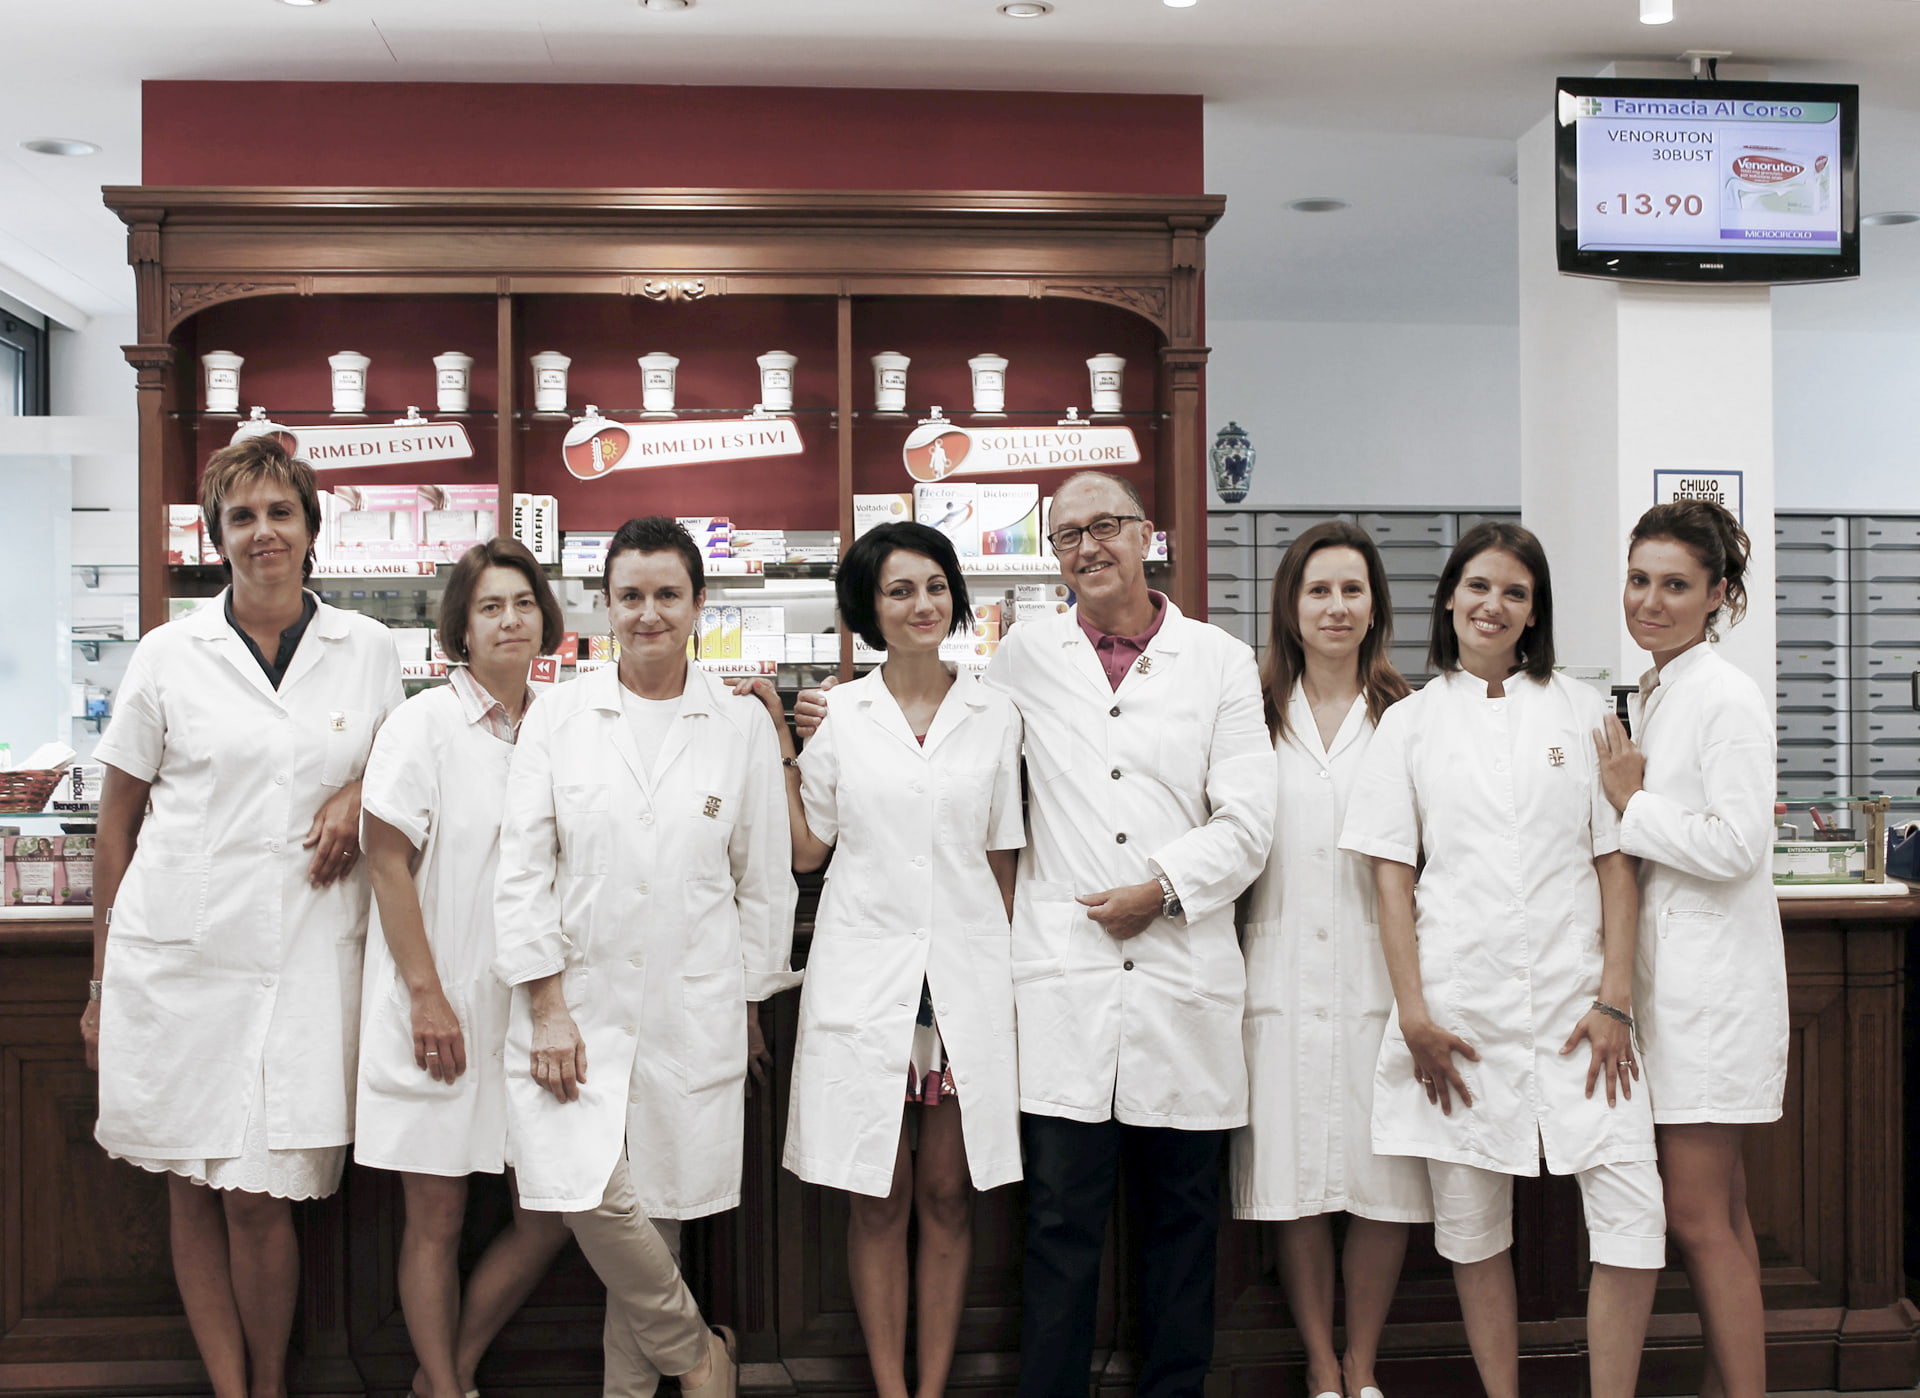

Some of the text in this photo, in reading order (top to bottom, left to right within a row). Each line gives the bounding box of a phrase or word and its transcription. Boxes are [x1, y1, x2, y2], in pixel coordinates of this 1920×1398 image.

[1614, 99, 1802, 118] Farmacia Al Corso
[1607, 130, 1713, 143] VENORUTON
[1652, 149, 1713, 161] 30BUST
[1737, 158, 1800, 173] Venoruton
[1617, 193, 1703, 218] 13,90
[309, 435, 455, 460] RIMEDI ESTIVI
[642, 430, 785, 456] RIMEDI ESTIVI
[982, 432, 1082, 451] SOLLIEVO
[1007, 445, 1127, 466] DAL DOLORE
[1680, 479, 1718, 492] CHIUSO
[856, 504, 889, 512] Voltadol
[535, 508, 543, 552] BIAFIN
[318, 564, 409, 573] DELLE GAMBE
[588, 564, 604, 572] PU
[987, 563, 999, 571] DI
[1004, 563, 1059, 571] SCHIENA
[403, 666, 423, 675] NTI
[702, 665, 757, 673] LE-HERPES
[73, 767, 85, 800] negum
[53, 801, 90, 812] Benegum
